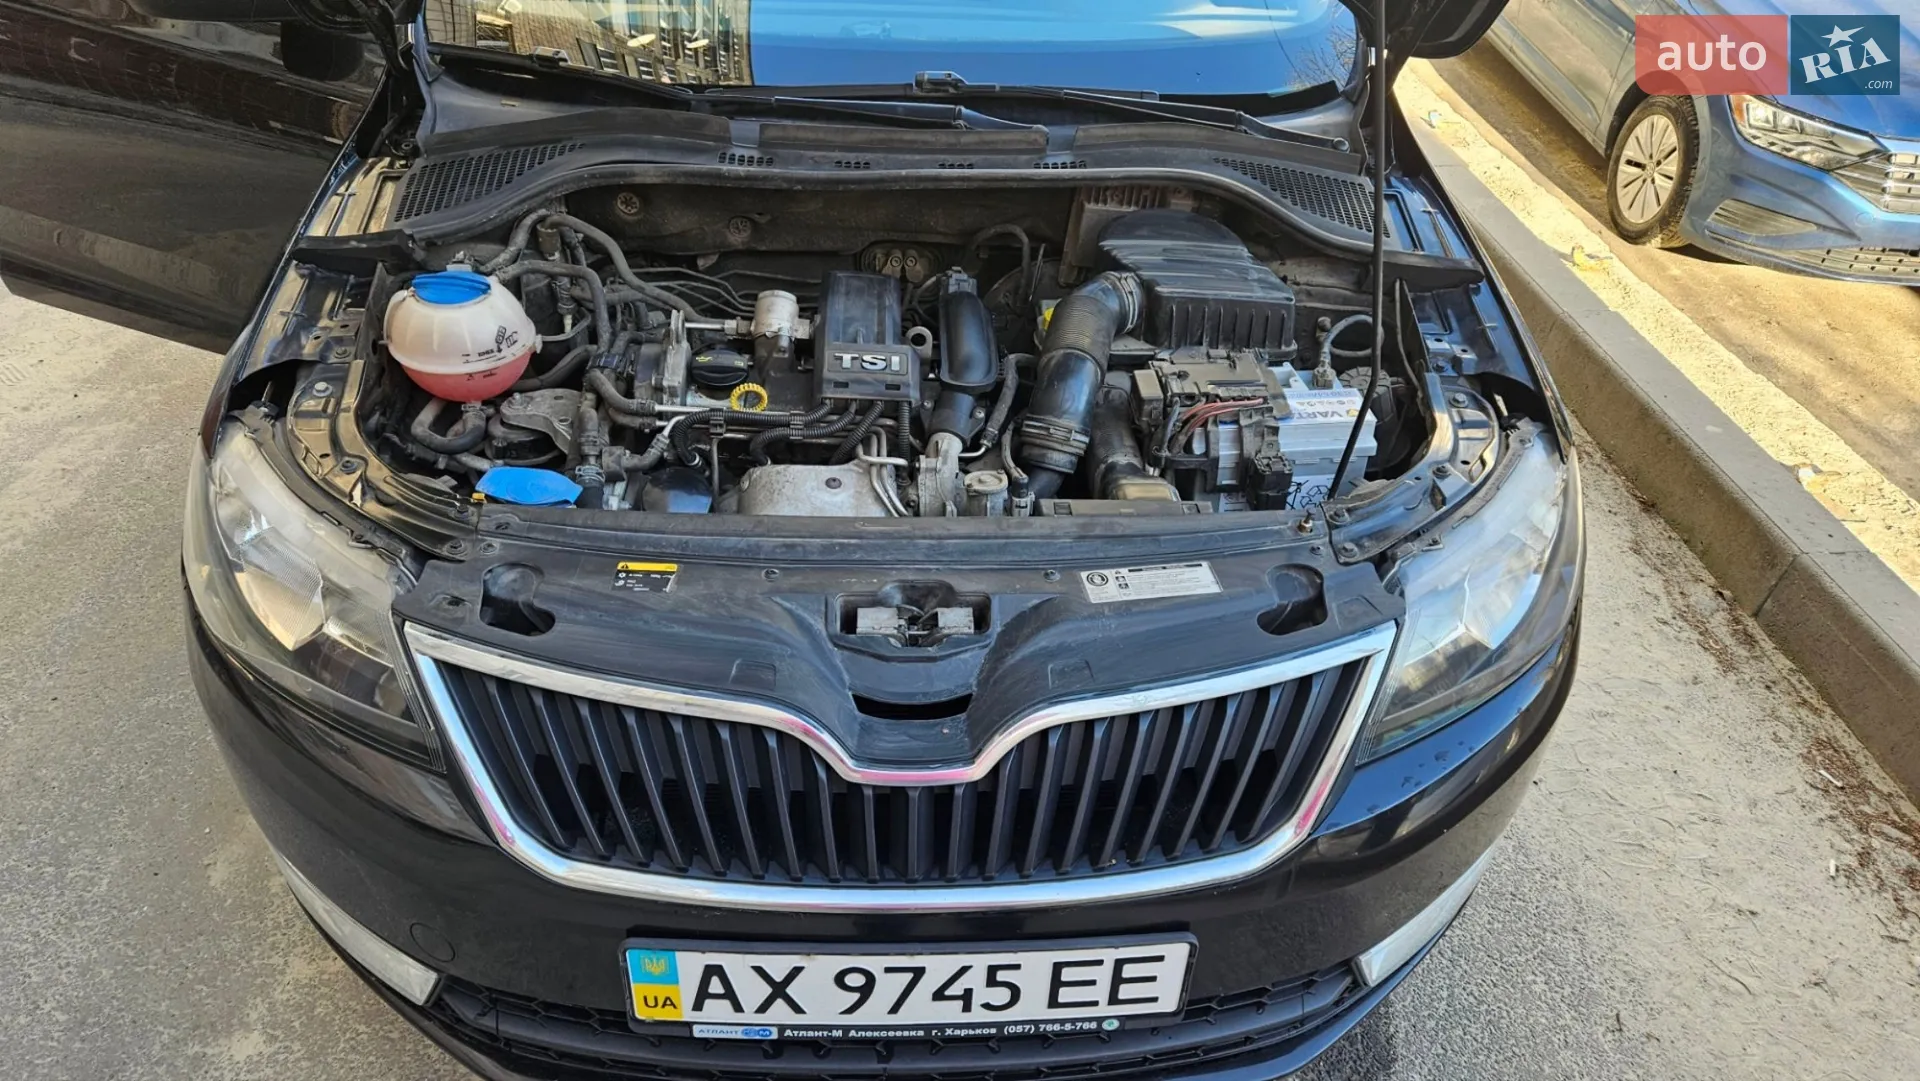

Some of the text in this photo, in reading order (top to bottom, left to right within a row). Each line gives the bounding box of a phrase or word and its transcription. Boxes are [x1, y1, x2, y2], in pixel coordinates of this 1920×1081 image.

[833, 352, 901, 371] TSI
[691, 955, 1165, 1015] AX 9745 EE
[643, 995, 678, 1009] UA
[784, 1029, 843, 1038] Атлант-М
[848, 1029, 925, 1038] Алексеевка
[944, 1027, 997, 1037] Харьков
[1003, 1024, 1035, 1035] (057)
[1038, 1021, 1097, 1032] 766-5-766
